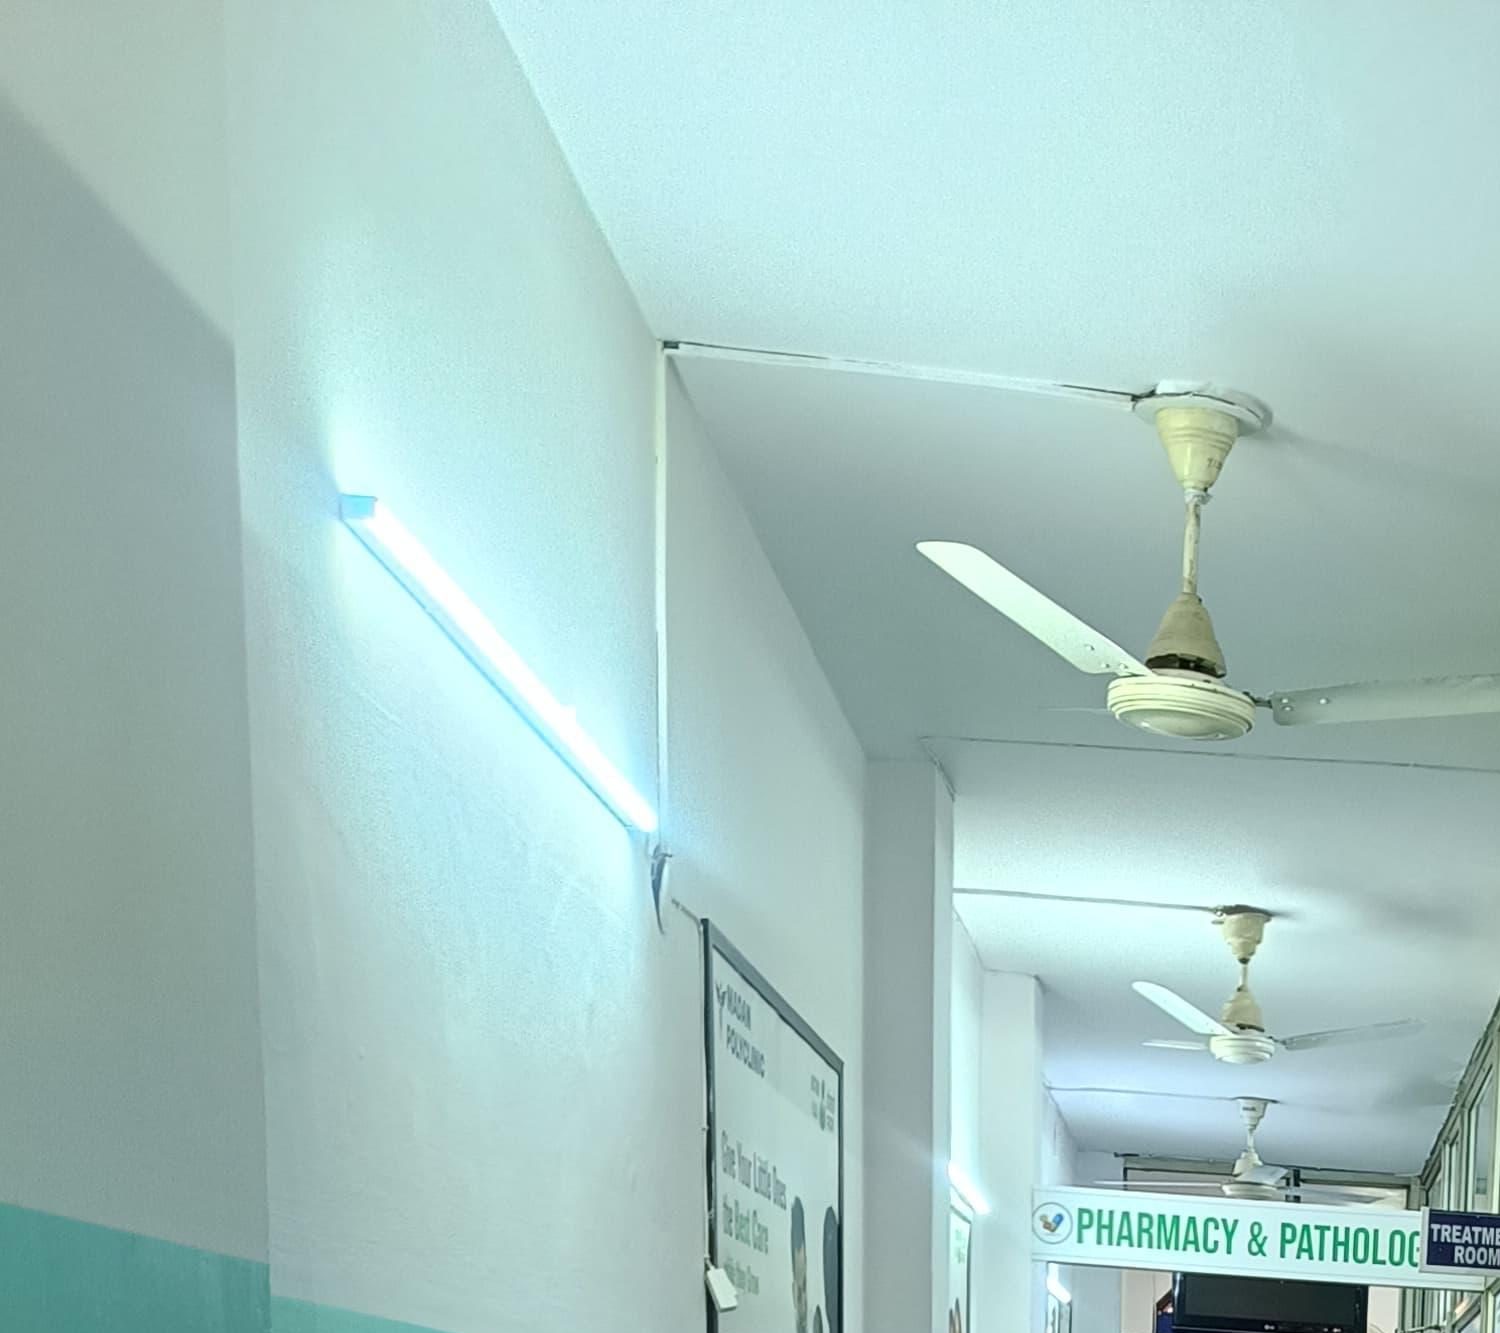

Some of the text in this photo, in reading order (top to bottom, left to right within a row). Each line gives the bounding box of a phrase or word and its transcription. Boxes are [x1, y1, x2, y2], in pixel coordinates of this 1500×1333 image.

[1076, 1207, 1421, 1269] PHARMACY & PATHOLOG
